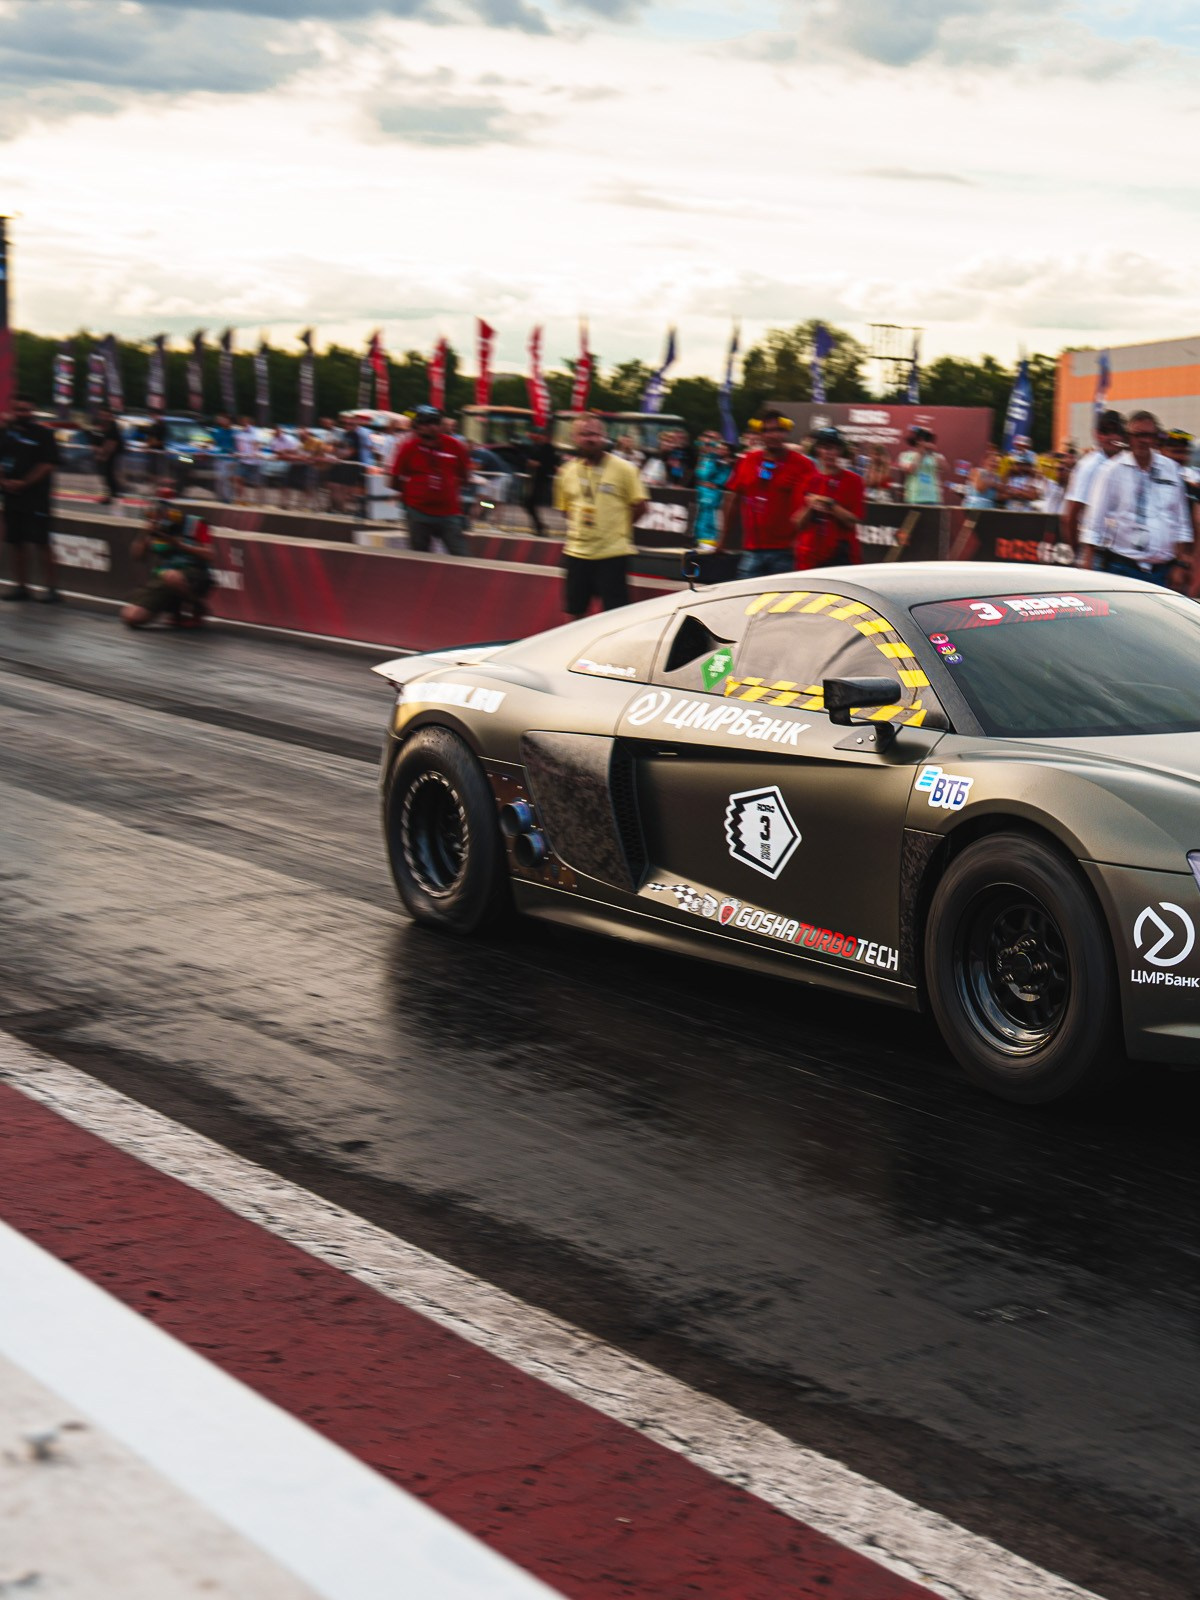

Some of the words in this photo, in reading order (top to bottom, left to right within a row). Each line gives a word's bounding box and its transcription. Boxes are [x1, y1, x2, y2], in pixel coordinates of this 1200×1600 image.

[969, 602, 1003, 621] 3
[663, 700, 812, 745] ЦМРБанк
[932, 778, 969, 805] ВТБ
[760, 815, 771, 841] 3
[1131, 969, 1200, 988] ЦМРБанк
